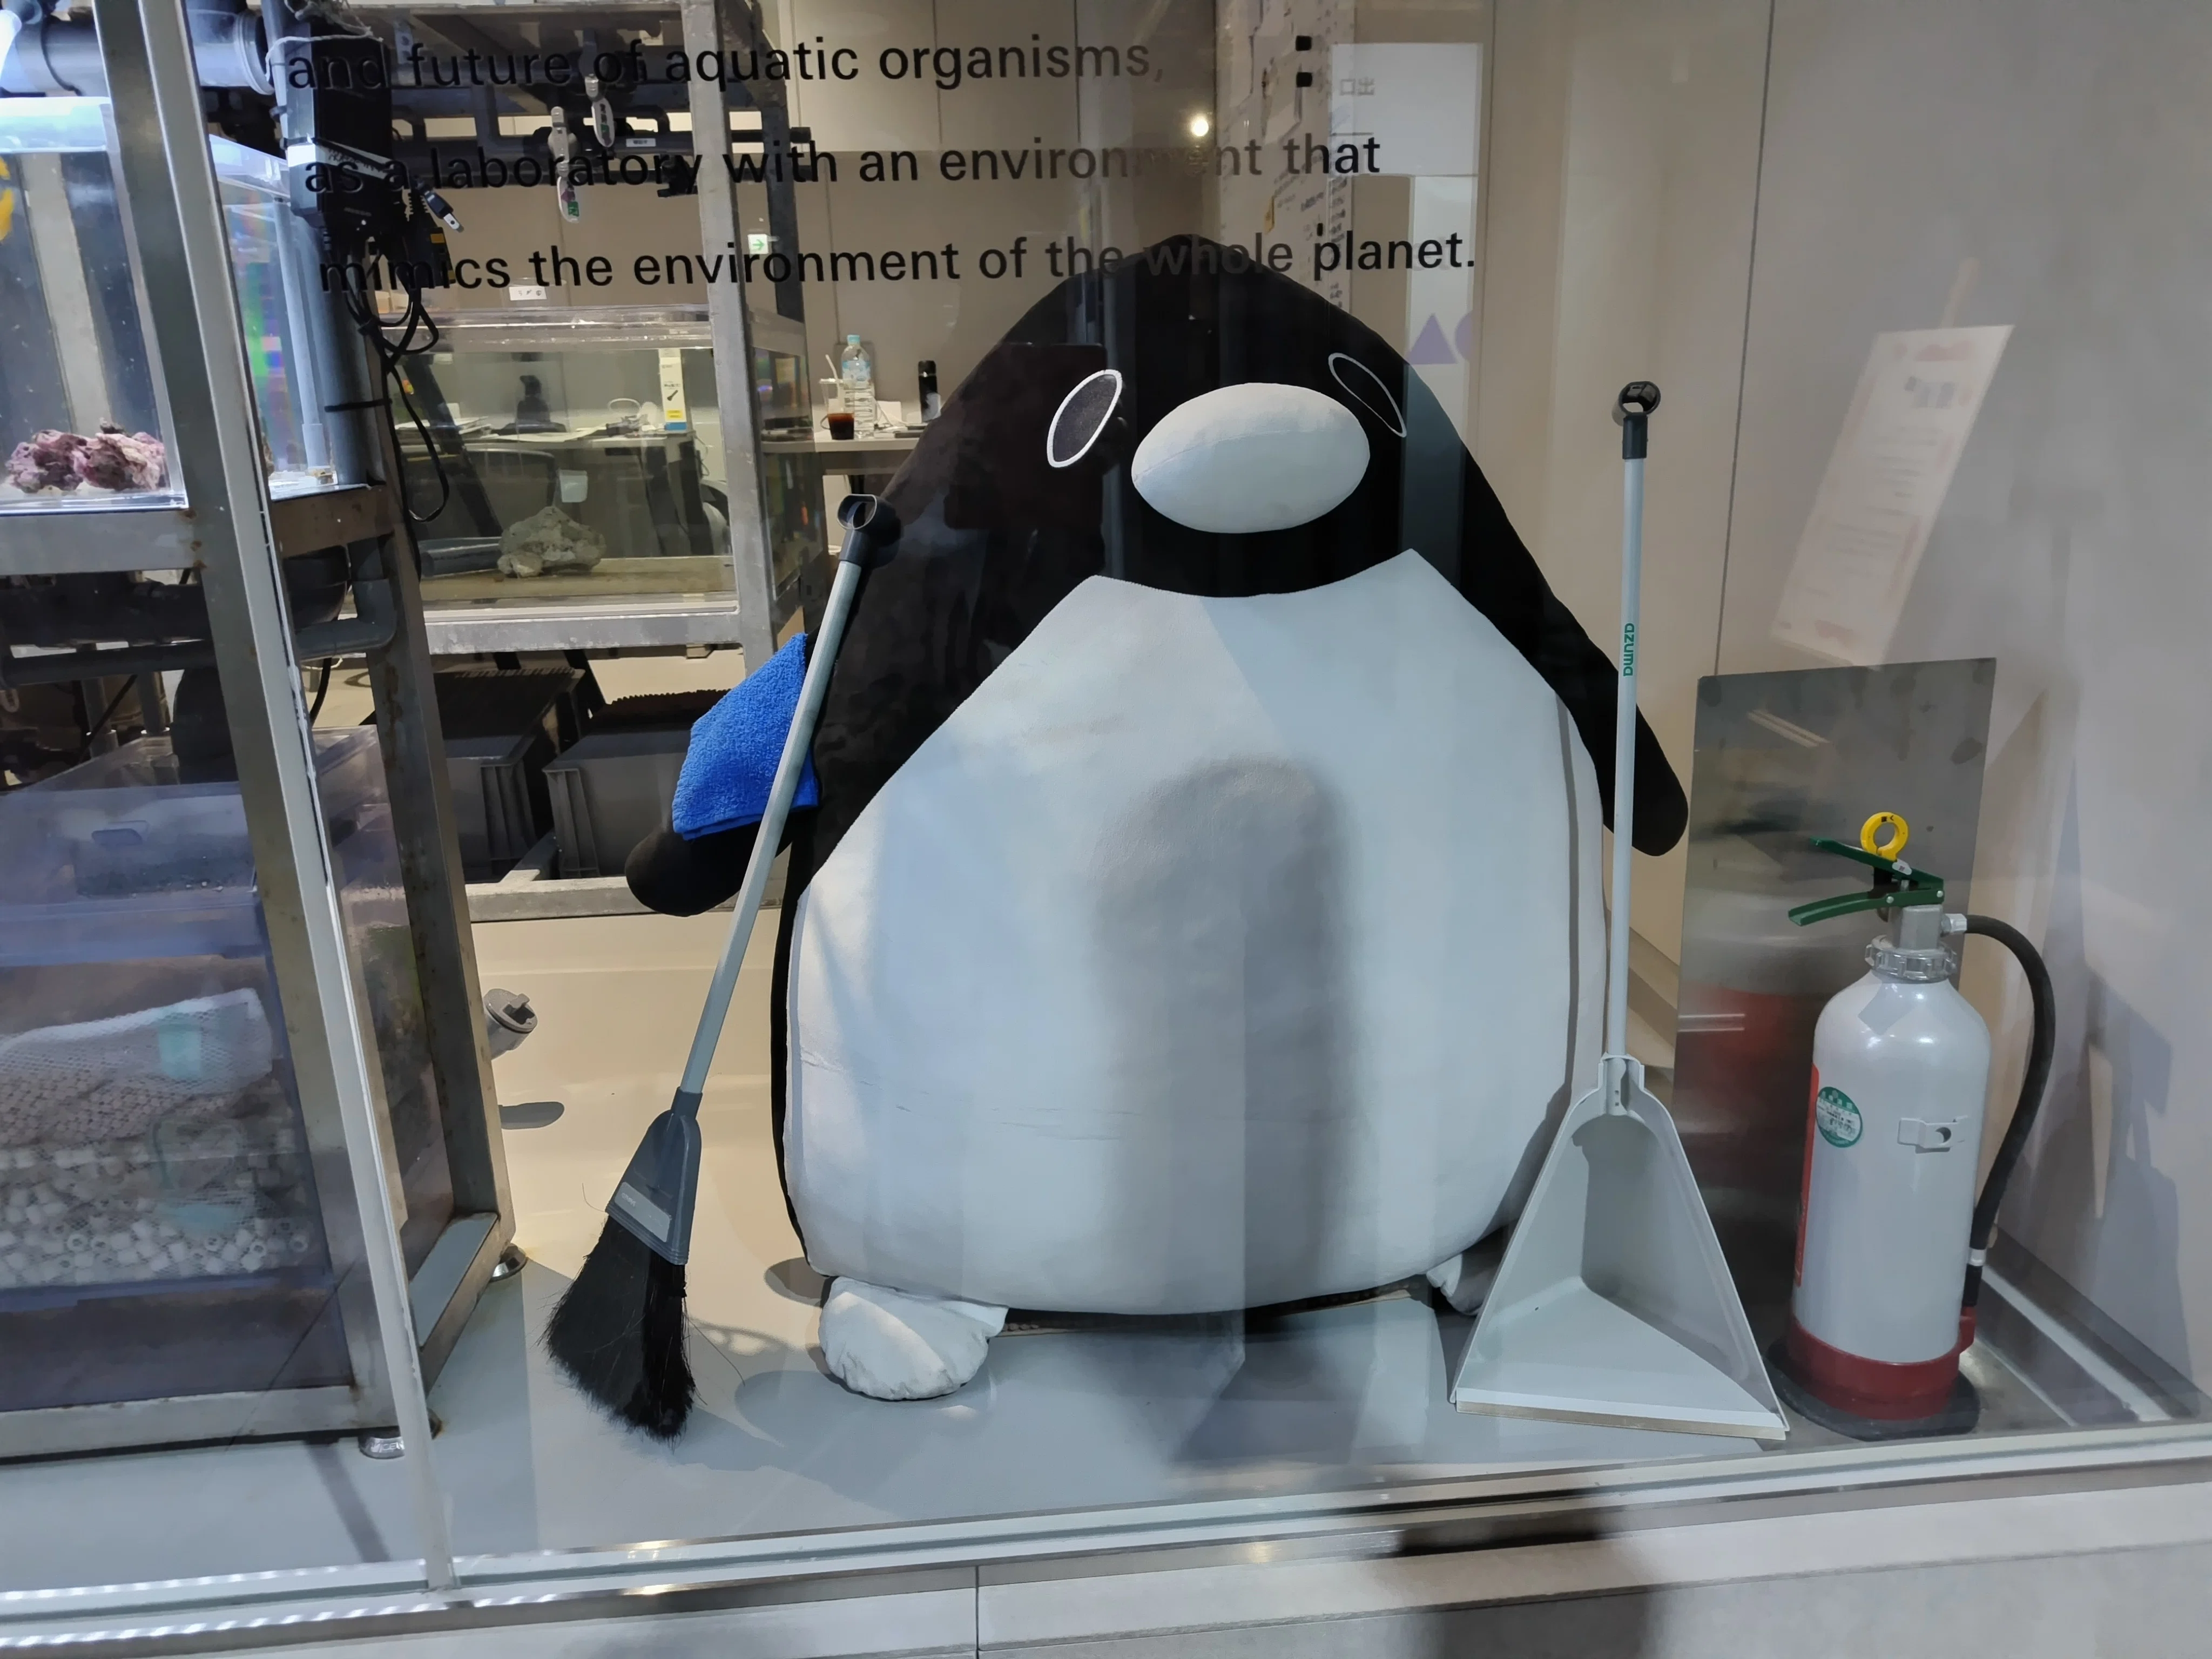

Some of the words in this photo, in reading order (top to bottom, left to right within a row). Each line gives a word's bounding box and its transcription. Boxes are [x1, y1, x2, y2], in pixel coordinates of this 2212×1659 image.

[288, 46, 388, 89] and
[407, 43, 572, 86] future
[594, 39, 644, 83] of
[666, 37, 859, 92] aquatic
[879, 33, 1163, 90] organisms,
[305, 161, 363, 193] as
[383, 160, 411, 191] a
[431, 146, 702, 194] laboratory
[723, 140, 837, 183] with
[859, 150, 918, 182] an
[940, 137, 1262, 181] environnt
[1283, 133, 1380, 175] that
[320, 248, 510, 292] mimics
[528, 246, 612, 286] the
[634, 242, 960, 285] environment
[979, 237, 1027, 279] of
[1046, 237, 1123, 277] the
[1142, 233, 1293, 276] whole
[1313, 230, 1474, 281] planet.
[1623, 623, 1634, 676] azuma
